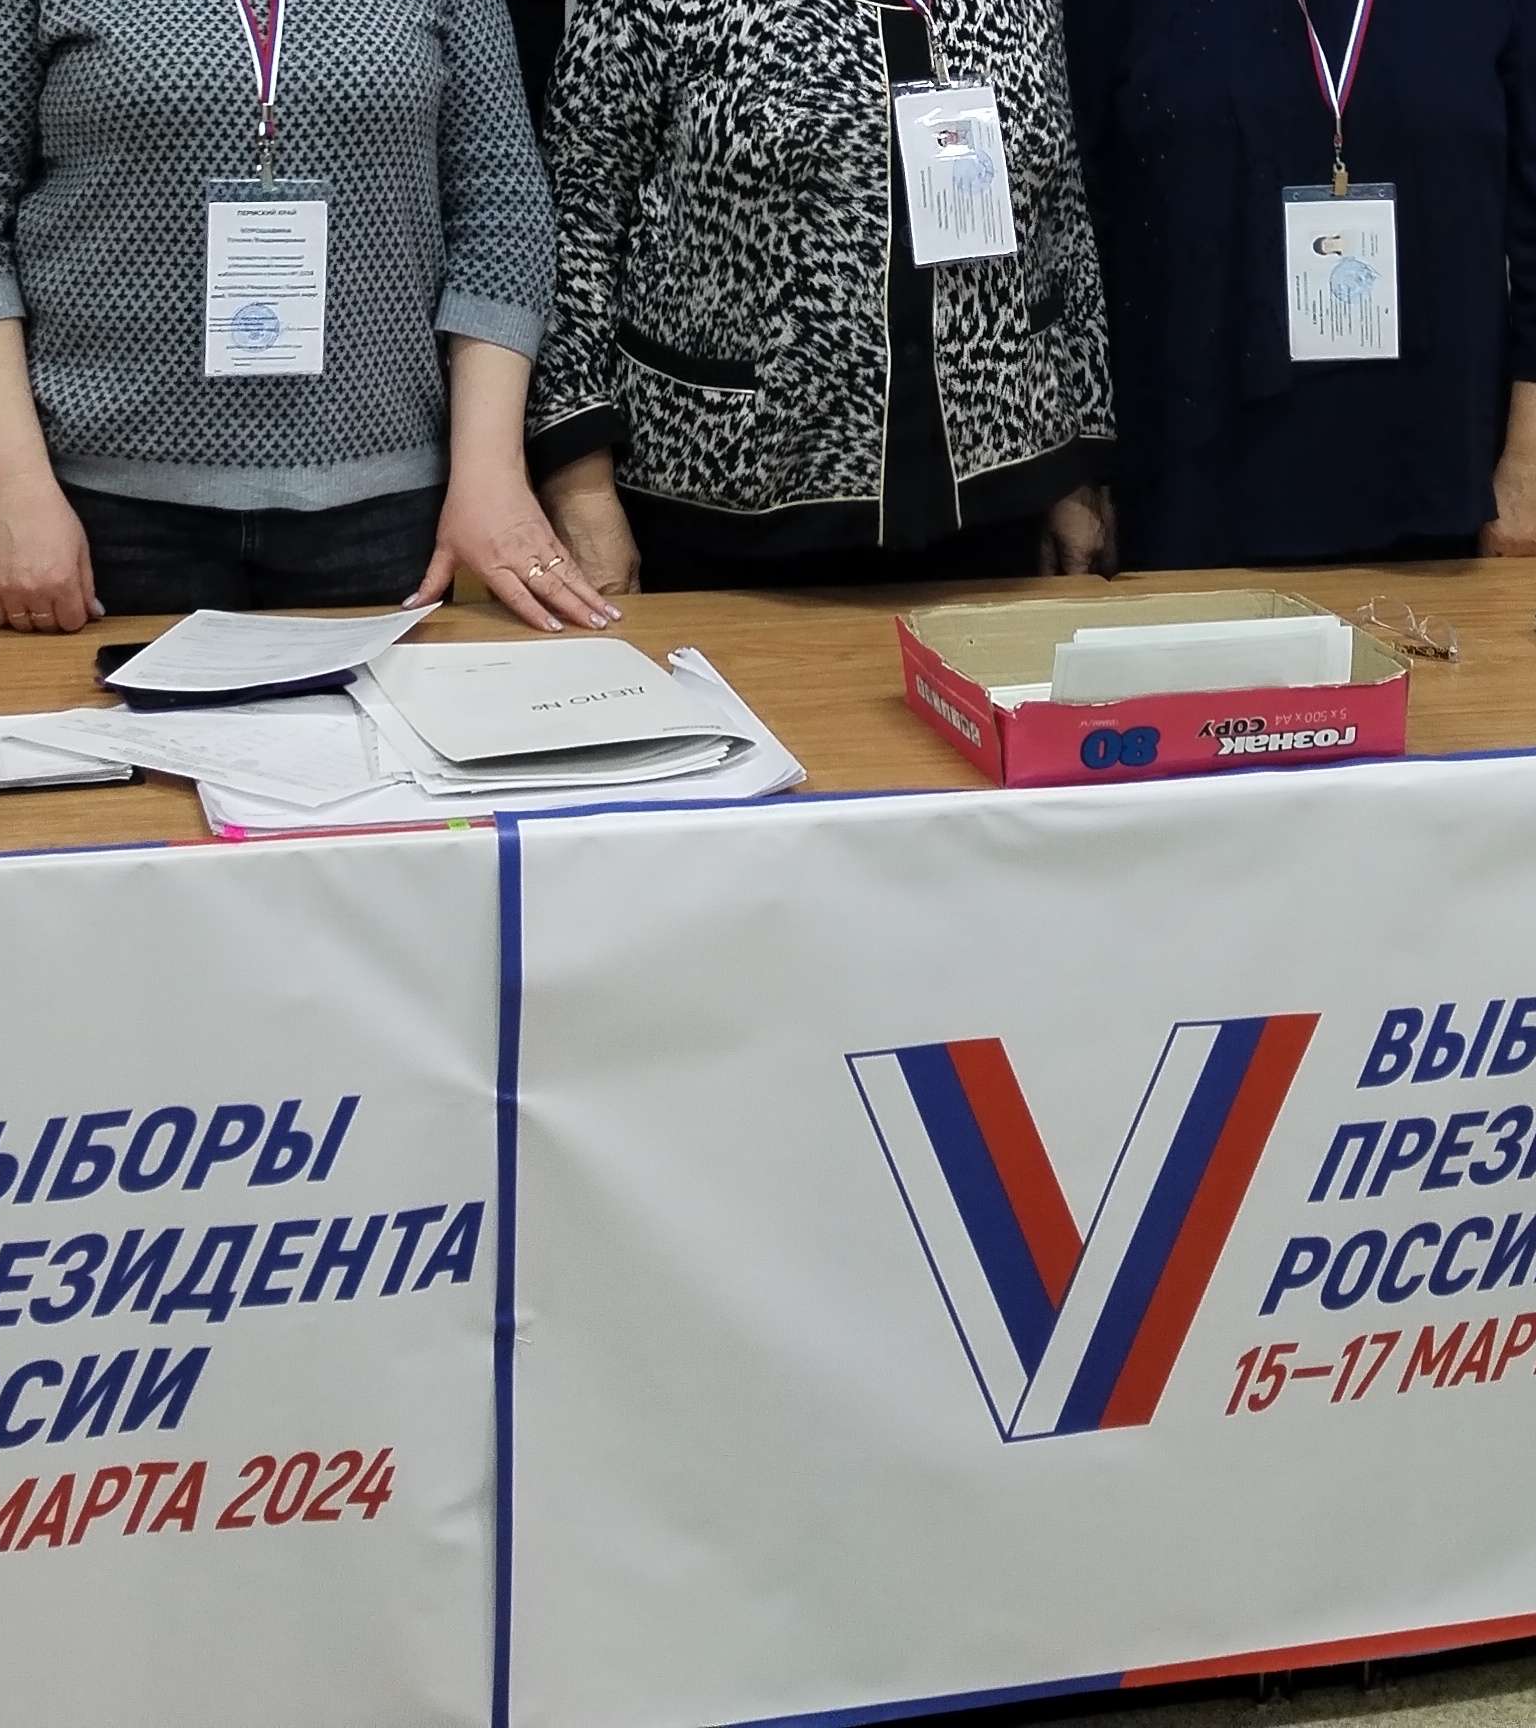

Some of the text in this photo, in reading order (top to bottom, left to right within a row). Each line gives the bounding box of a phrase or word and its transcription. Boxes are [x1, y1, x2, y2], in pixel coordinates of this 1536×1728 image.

[569, 685, 645, 705] ДЕЛО
[1304, 709, 1328, 723] 500
[1339, 707, 1348, 720] 5
[1197, 716, 1267, 739] COPY
[1080, 726, 1160, 769] 80
[215, 1446, 396, 1530] 2024
